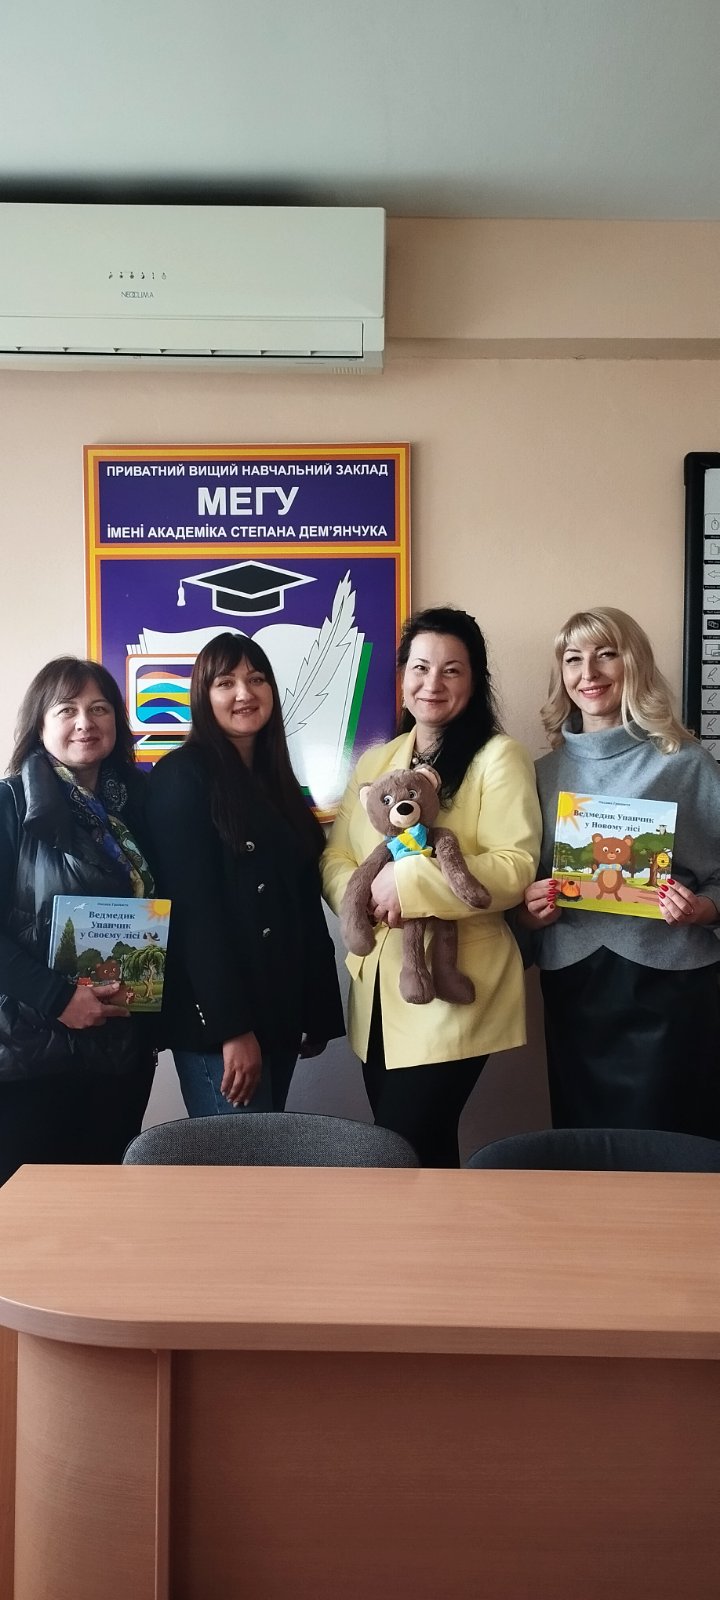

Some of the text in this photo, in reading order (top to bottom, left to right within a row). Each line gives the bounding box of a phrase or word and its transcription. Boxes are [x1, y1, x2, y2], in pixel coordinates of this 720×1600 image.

[106, 463, 389, 478] ПРИВАТНИЙ ВИЩИЙ НАВЧАЛЬНИЙ ЗАКЛАД
[197, 486, 300, 516] МЕГУ
[230, 526, 296, 538] СТЕПАНА
[298, 525, 388, 540] ДЕМ’ЯНЧУКА
[573, 809, 655, 824] Ведмедик Упанчик
[591, 821, 623, 832] Новому
[88, 911, 136, 920] Ведмедик
[91, 921, 132, 929] Упанчик
[80, 930, 141, 941] у Своєму лісі
